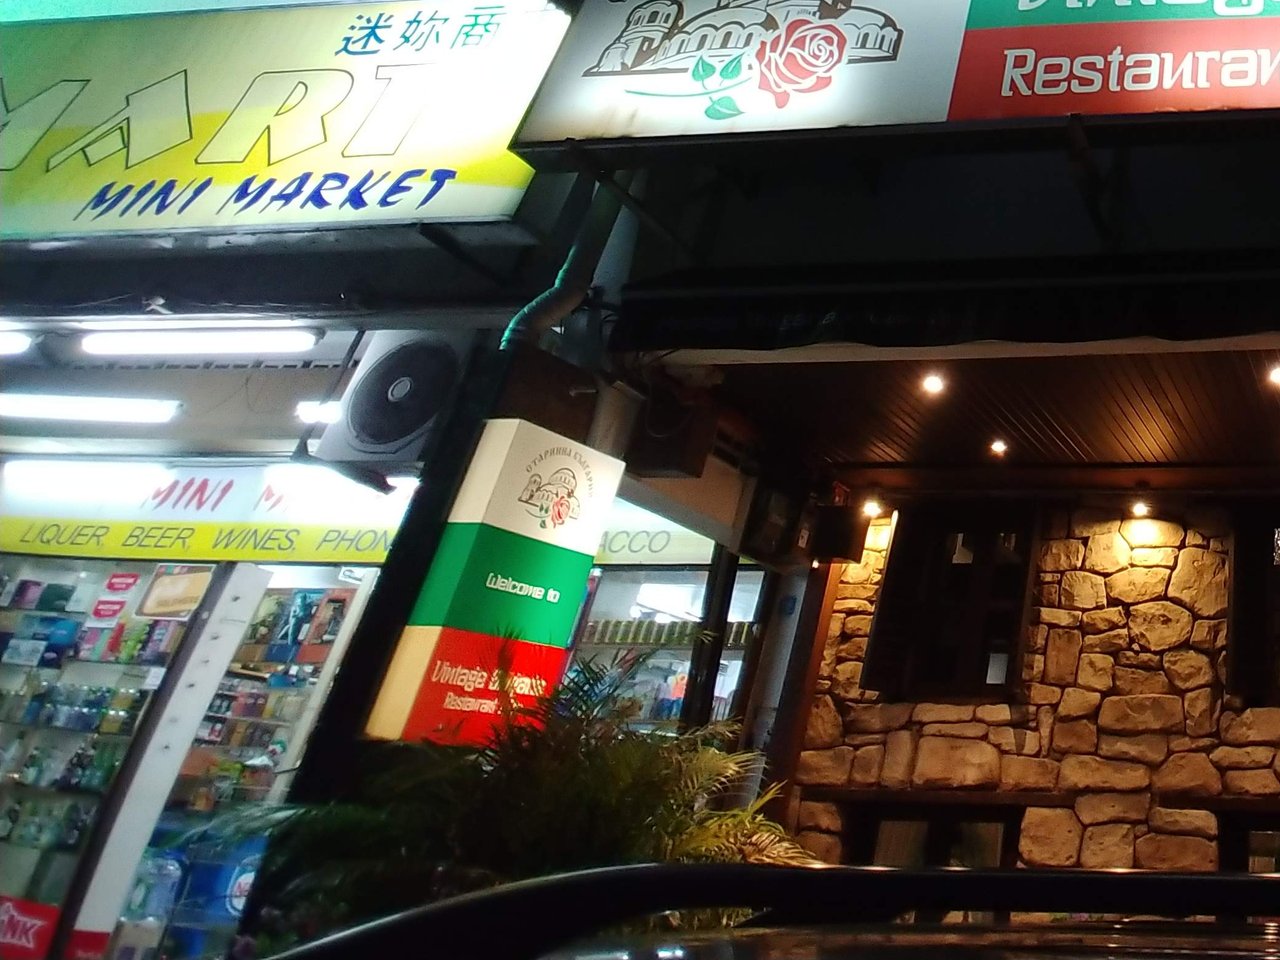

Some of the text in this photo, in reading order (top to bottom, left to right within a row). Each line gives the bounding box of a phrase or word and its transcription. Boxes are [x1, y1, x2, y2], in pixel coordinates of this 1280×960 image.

[73, 167, 458, 222] MINI MARKET
[141, 477, 234, 513] MINI
[486, 572, 561, 603] Welcome to
[431, 660, 488, 692] Vintage
